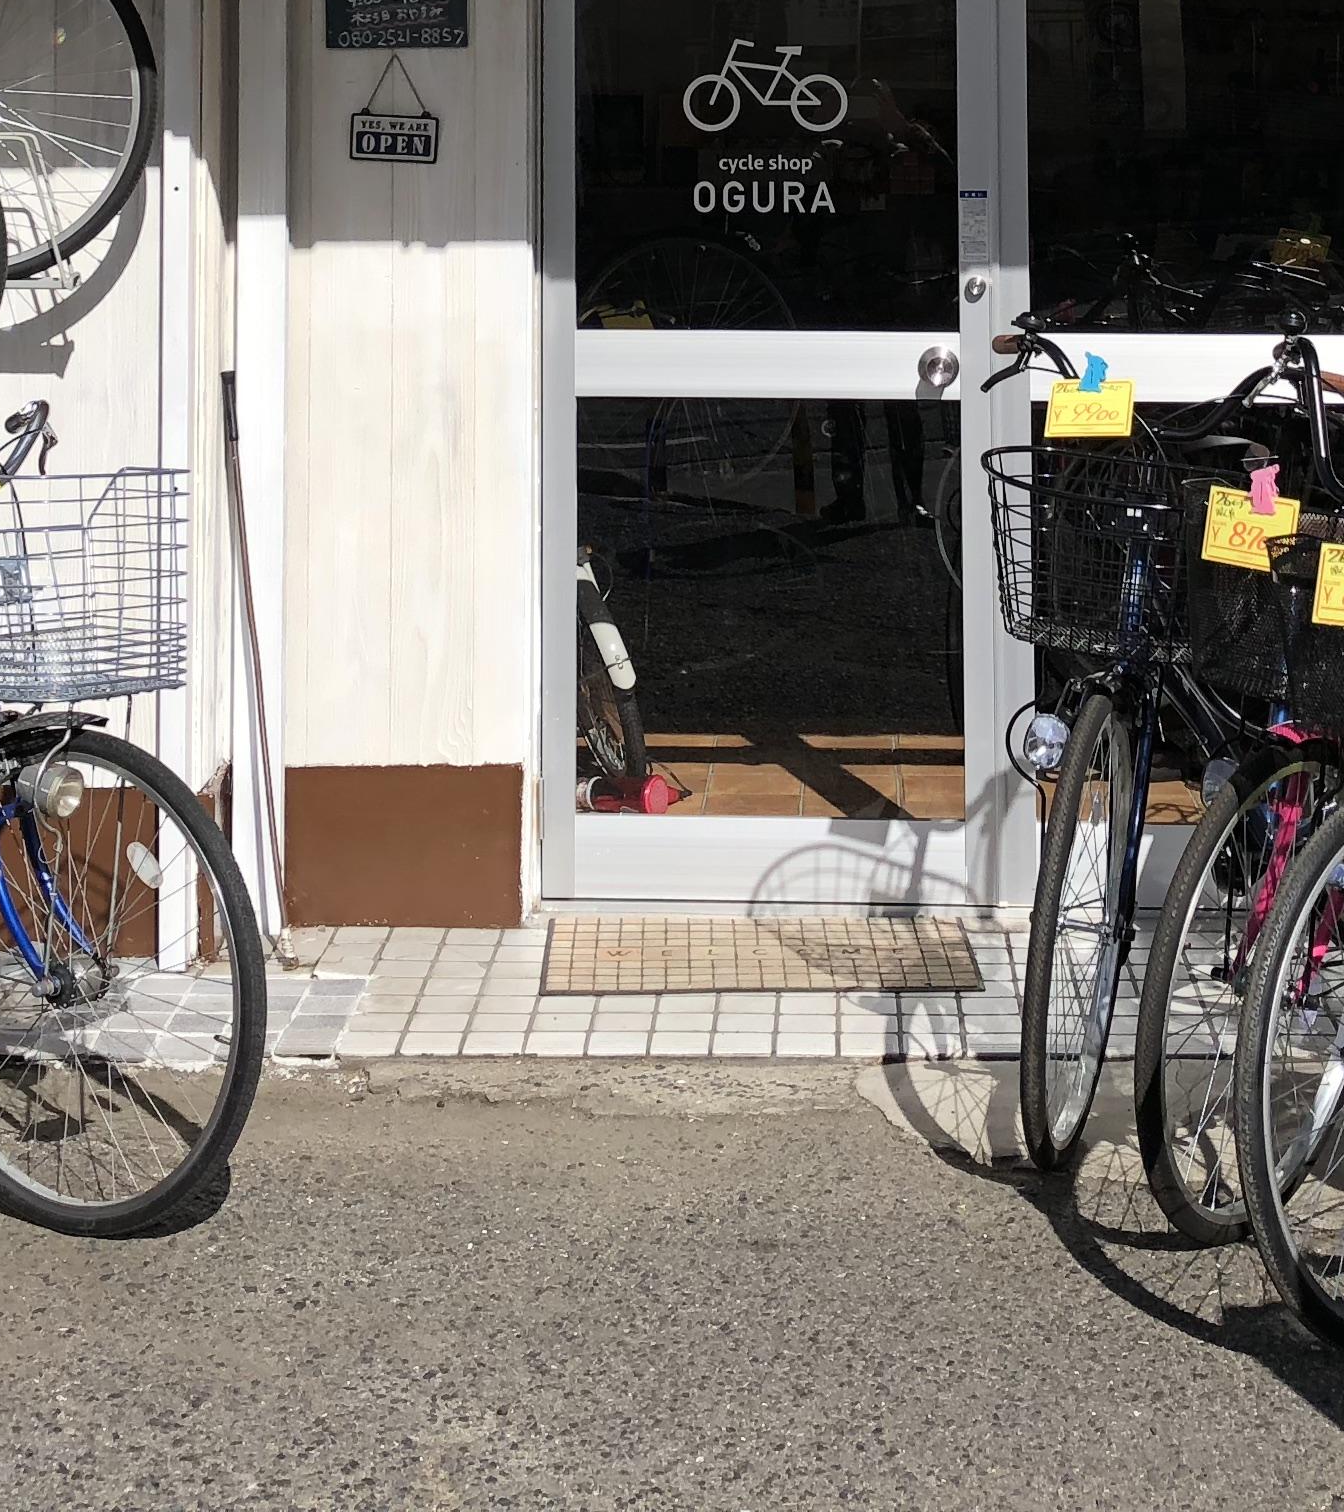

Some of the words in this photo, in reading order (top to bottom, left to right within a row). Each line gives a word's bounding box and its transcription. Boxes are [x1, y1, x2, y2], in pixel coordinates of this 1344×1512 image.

[389, 122, 405, 131] WE
[409, 123, 429, 133] ARE
[361, 134, 426, 155] OPEN
[718, 154, 764, 174] cycle
[768, 154, 812, 172] shop
[693, 181, 836, 214] OGURA
